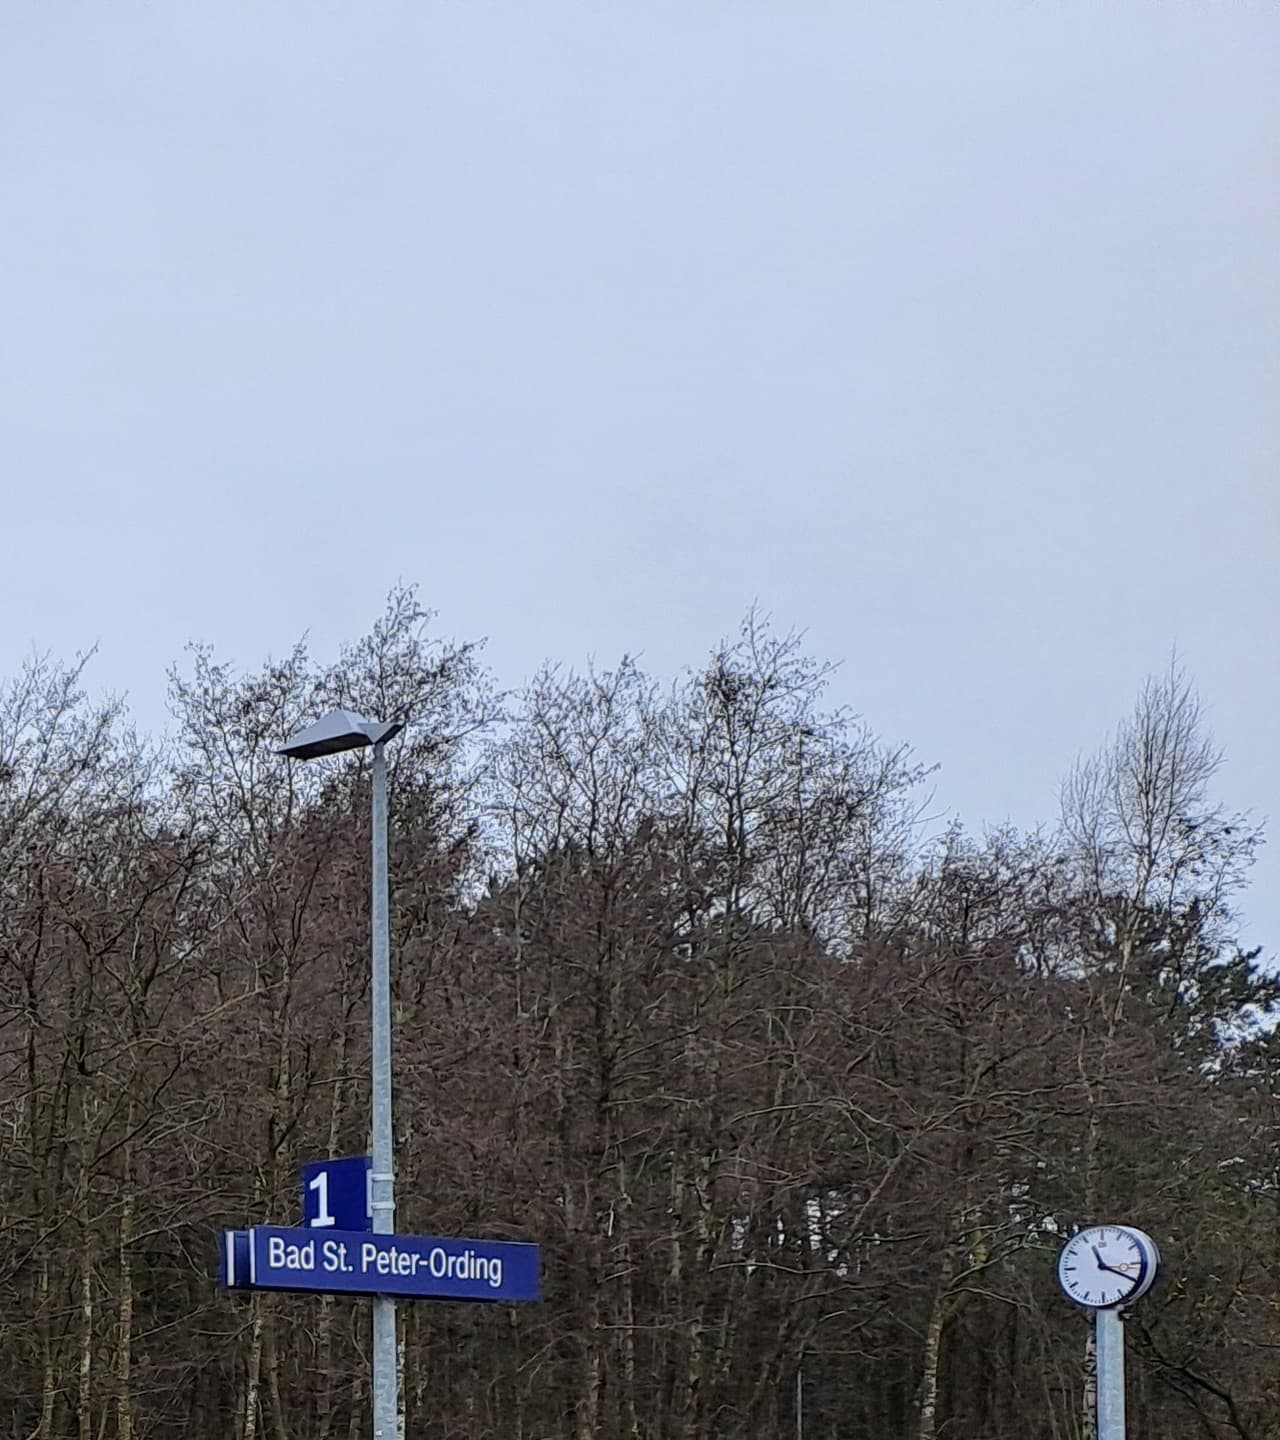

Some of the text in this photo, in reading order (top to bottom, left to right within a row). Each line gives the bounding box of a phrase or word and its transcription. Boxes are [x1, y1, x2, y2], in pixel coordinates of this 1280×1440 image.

[309, 1171, 336, 1228] 1
[269, 1236, 502, 1288] Bad St. Peter-Ording
